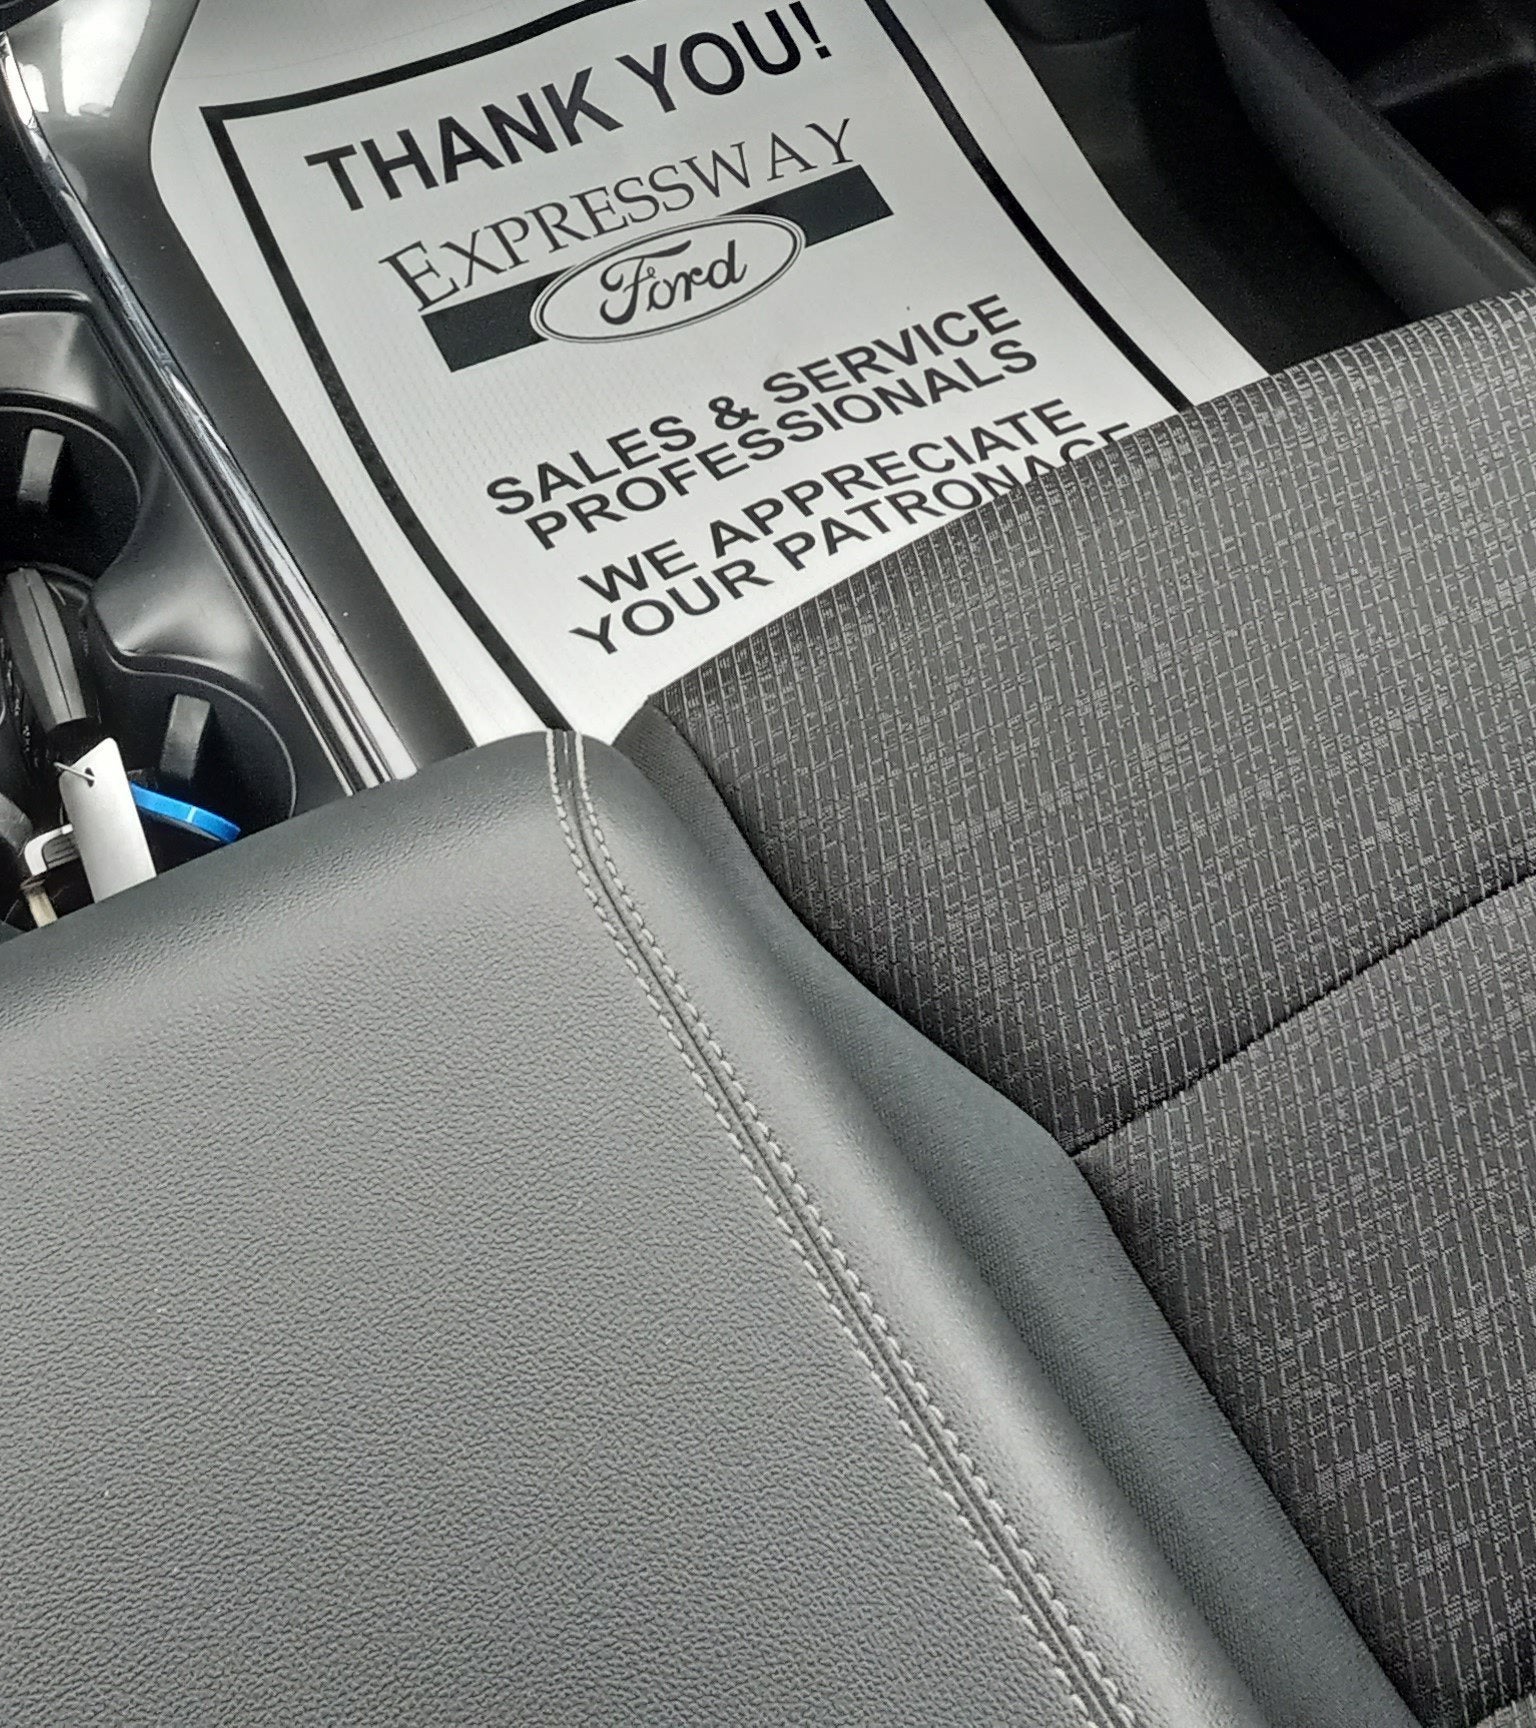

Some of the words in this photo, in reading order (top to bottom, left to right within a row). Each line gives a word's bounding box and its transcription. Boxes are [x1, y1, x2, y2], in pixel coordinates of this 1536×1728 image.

[303, 67, 624, 214] THANK
[617, 0, 834, 115] YOU!
[378, 118, 857, 311] EXPRESSWAY
[595, 241, 749, 327] Ford
[485, 414, 697, 516] SALES
[707, 395, 760, 431] &
[762, 293, 1023, 405] SERVICE
[524, 337, 1040, 551] PROFESSIONALS
[576, 538, 699, 604] WE
[707, 398, 1088, 560] APPRECIATE
[568, 557, 775, 656] YOUR
